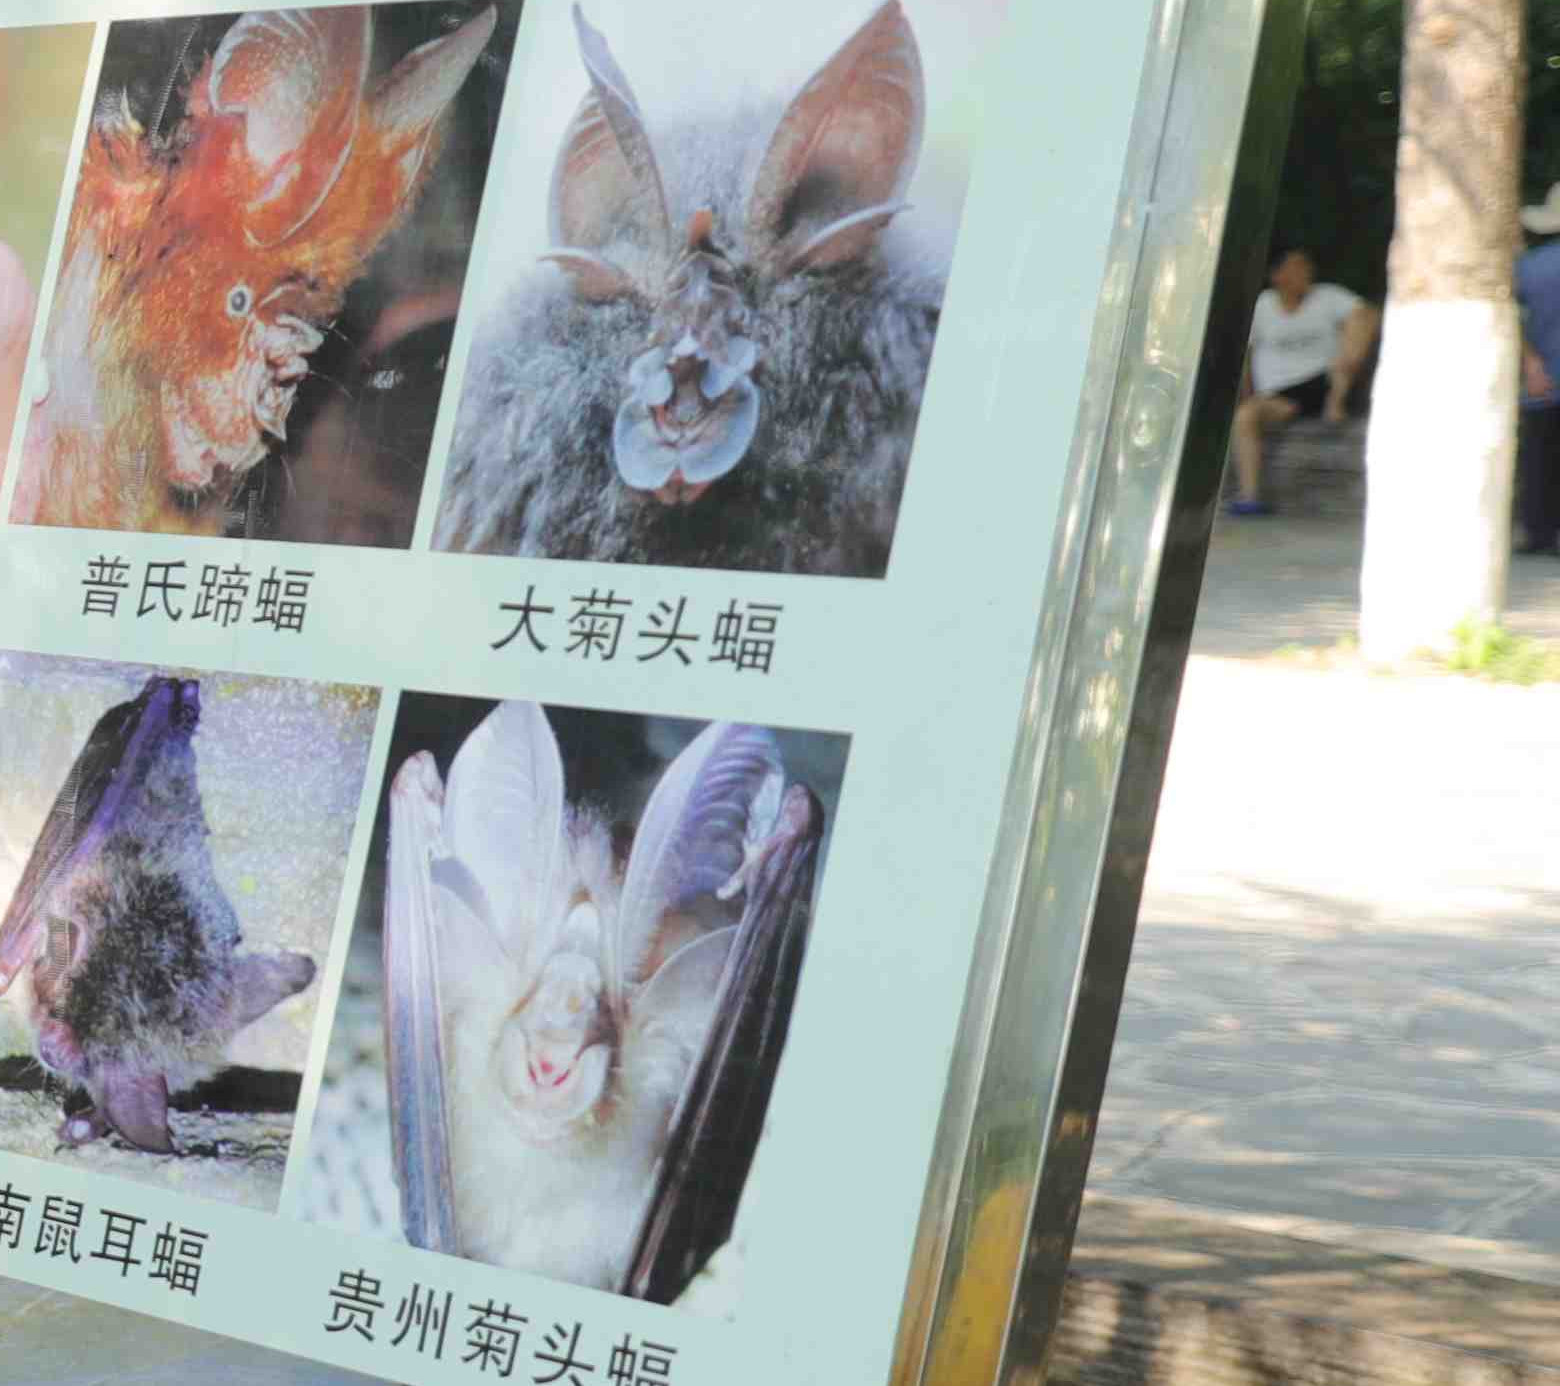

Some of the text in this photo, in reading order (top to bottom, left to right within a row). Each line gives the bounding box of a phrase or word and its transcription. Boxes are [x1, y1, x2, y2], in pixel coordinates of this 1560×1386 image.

[79, 554, 316, 635] 普氏蹄蝠
[489, 583, 786, 676] 大菊头蝠
